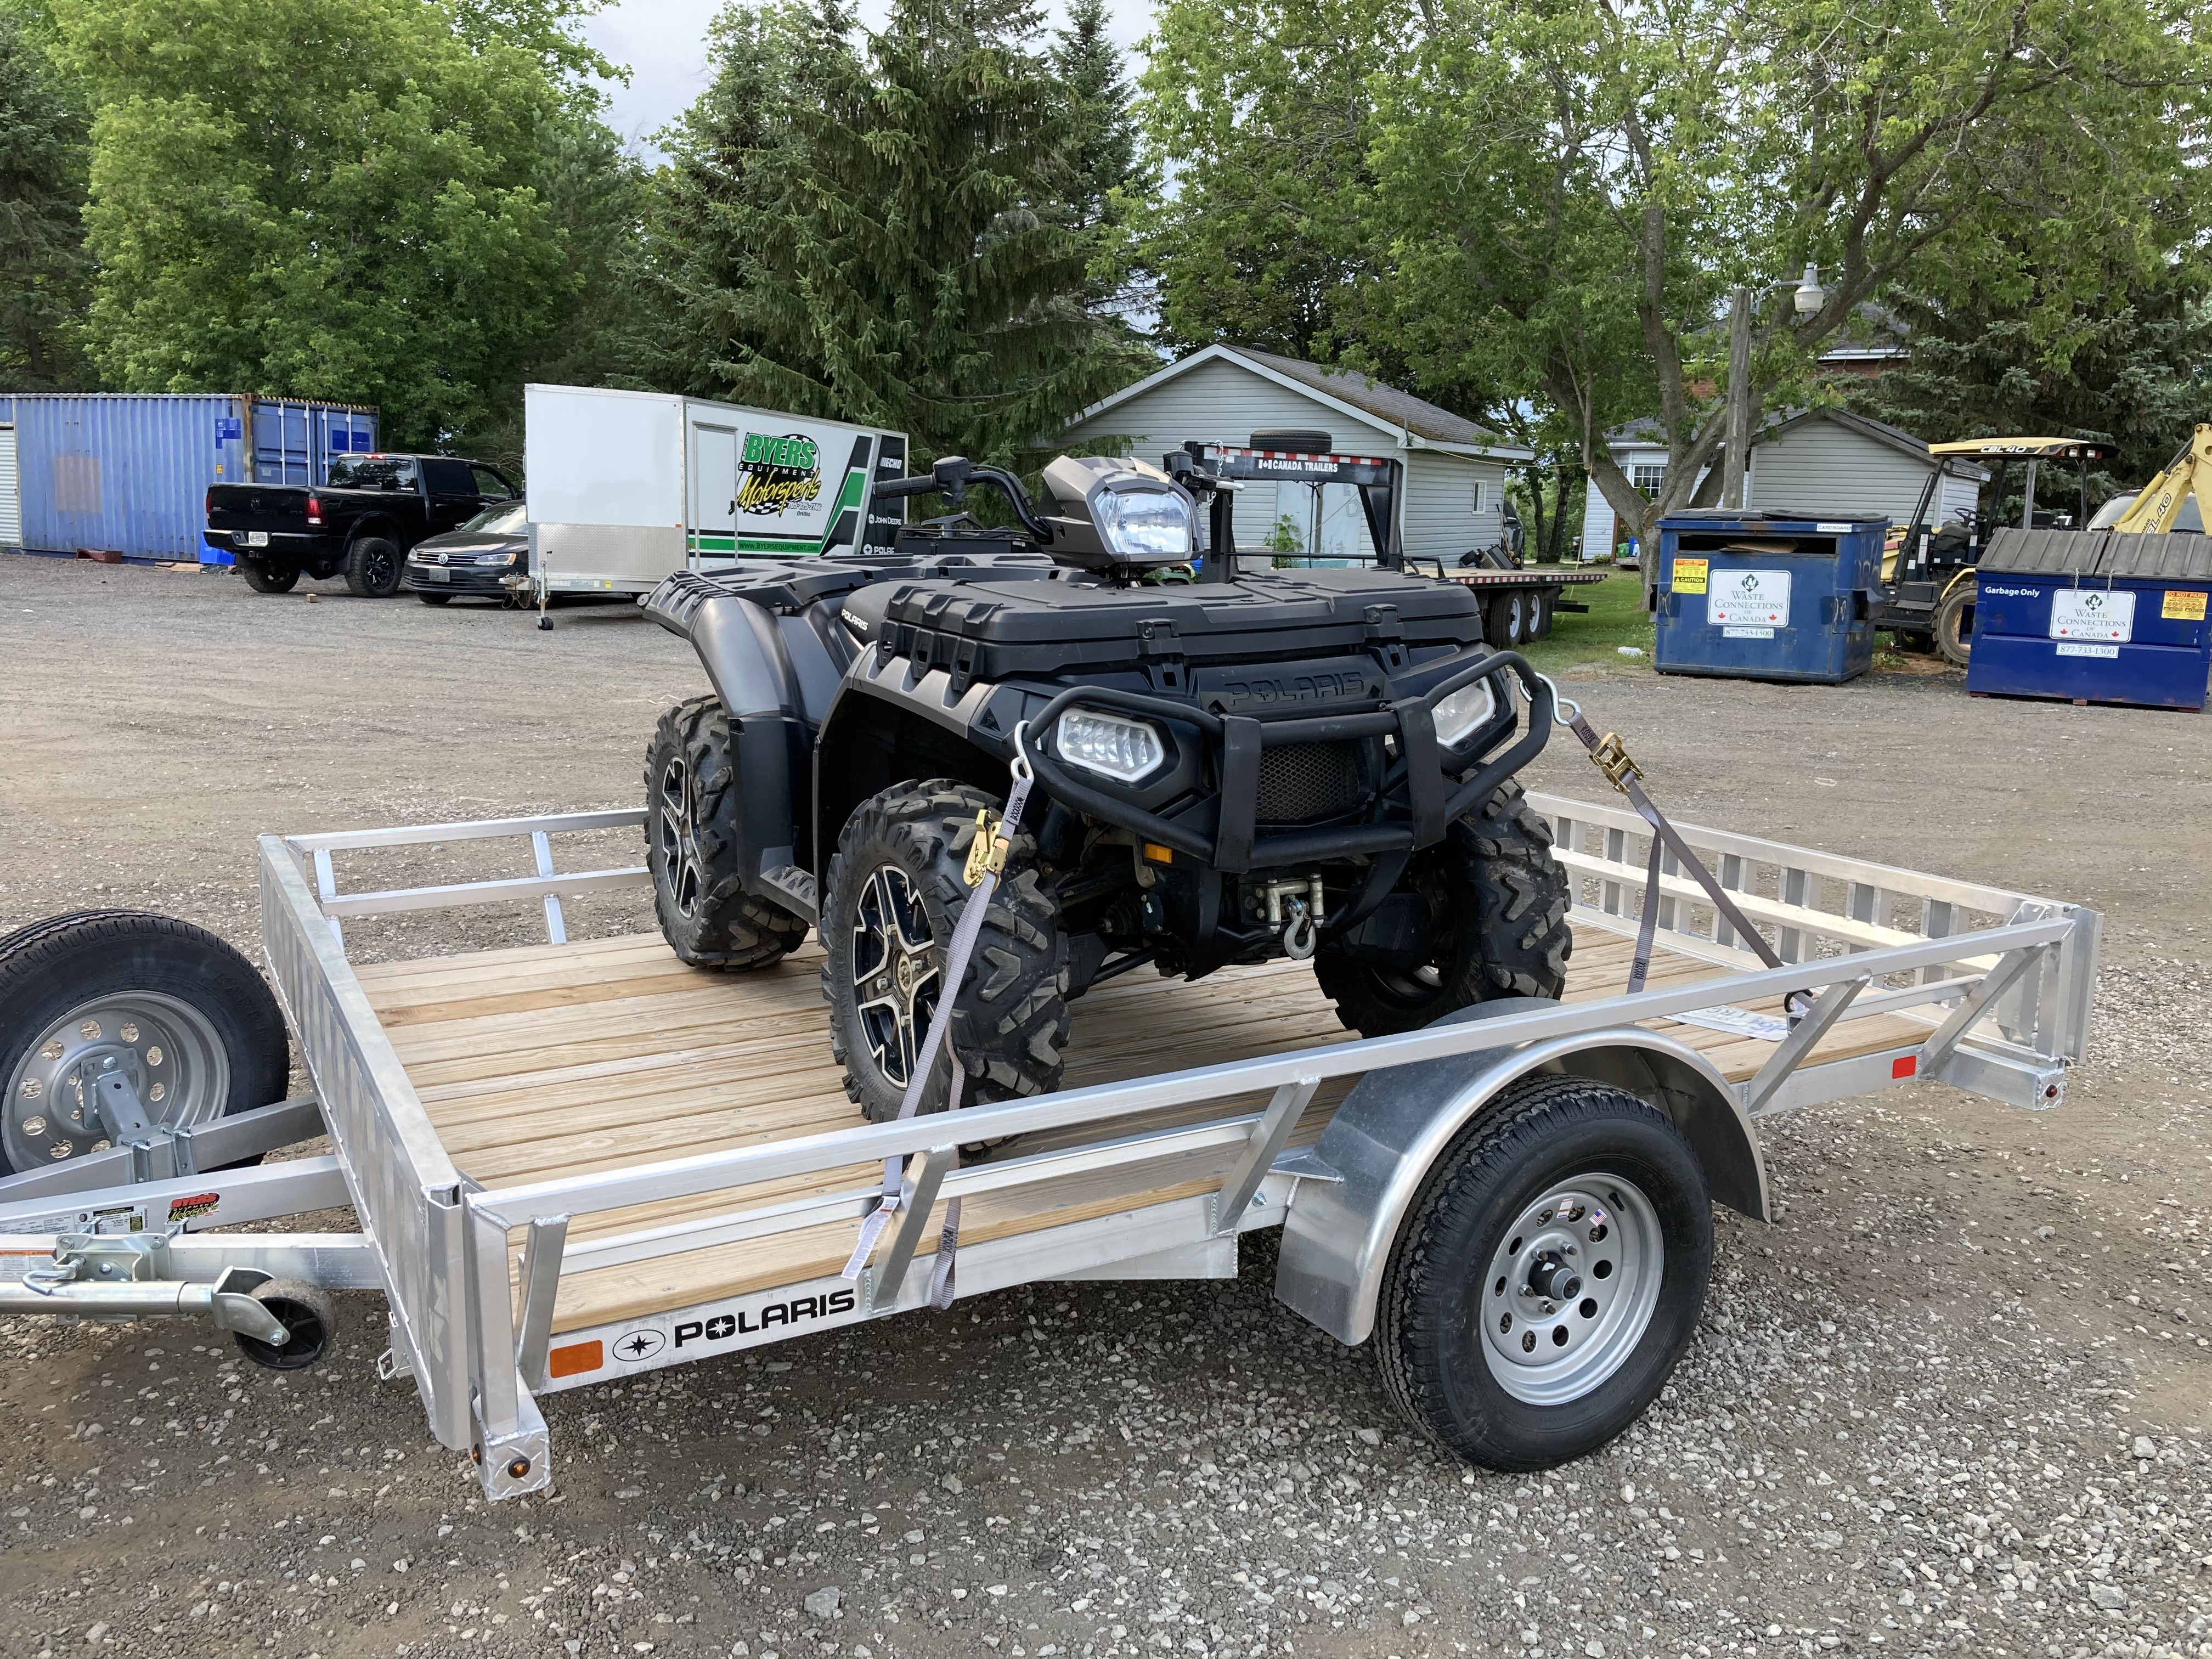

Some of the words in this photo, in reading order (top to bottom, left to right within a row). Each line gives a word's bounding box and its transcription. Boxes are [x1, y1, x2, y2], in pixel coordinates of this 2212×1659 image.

[744, 433, 816, 469] BYERS
[885, 458, 902, 470] ECHO
[1273, 460, 1302, 471] CANADA
[1305, 462, 1338, 473] TRAILERS
[738, 464, 815, 477] EQUIPMENT
[737, 467, 822, 518] Motorsports
[787, 501, 822, 511] 705-325-2746
[2157, 493, 2172, 518] 40
[875, 516, 888, 524] JOHN
[888, 517, 902, 525] DEERE
[1731, 591, 1764, 601] WASTE
[1985, 586, 2019, 596] Garbage
[2020, 589, 2040, 597] Only
[1714, 599, 1784, 610] CONNECTIONS
[1729, 613, 1767, 623] CANADA
[2075, 608, 2107, 618] WASTE
[842, 608, 868, 631] POLARIS
[2057, 616, 2126, 627] CONNECTIONS
[2071, 629, 2108, 639] CANADA
[2060, 645, 2115, 656] 877-733-1300
[1224, 671, 1365, 707] POLARIS
[674, 1288, 855, 1348] POLARIS
